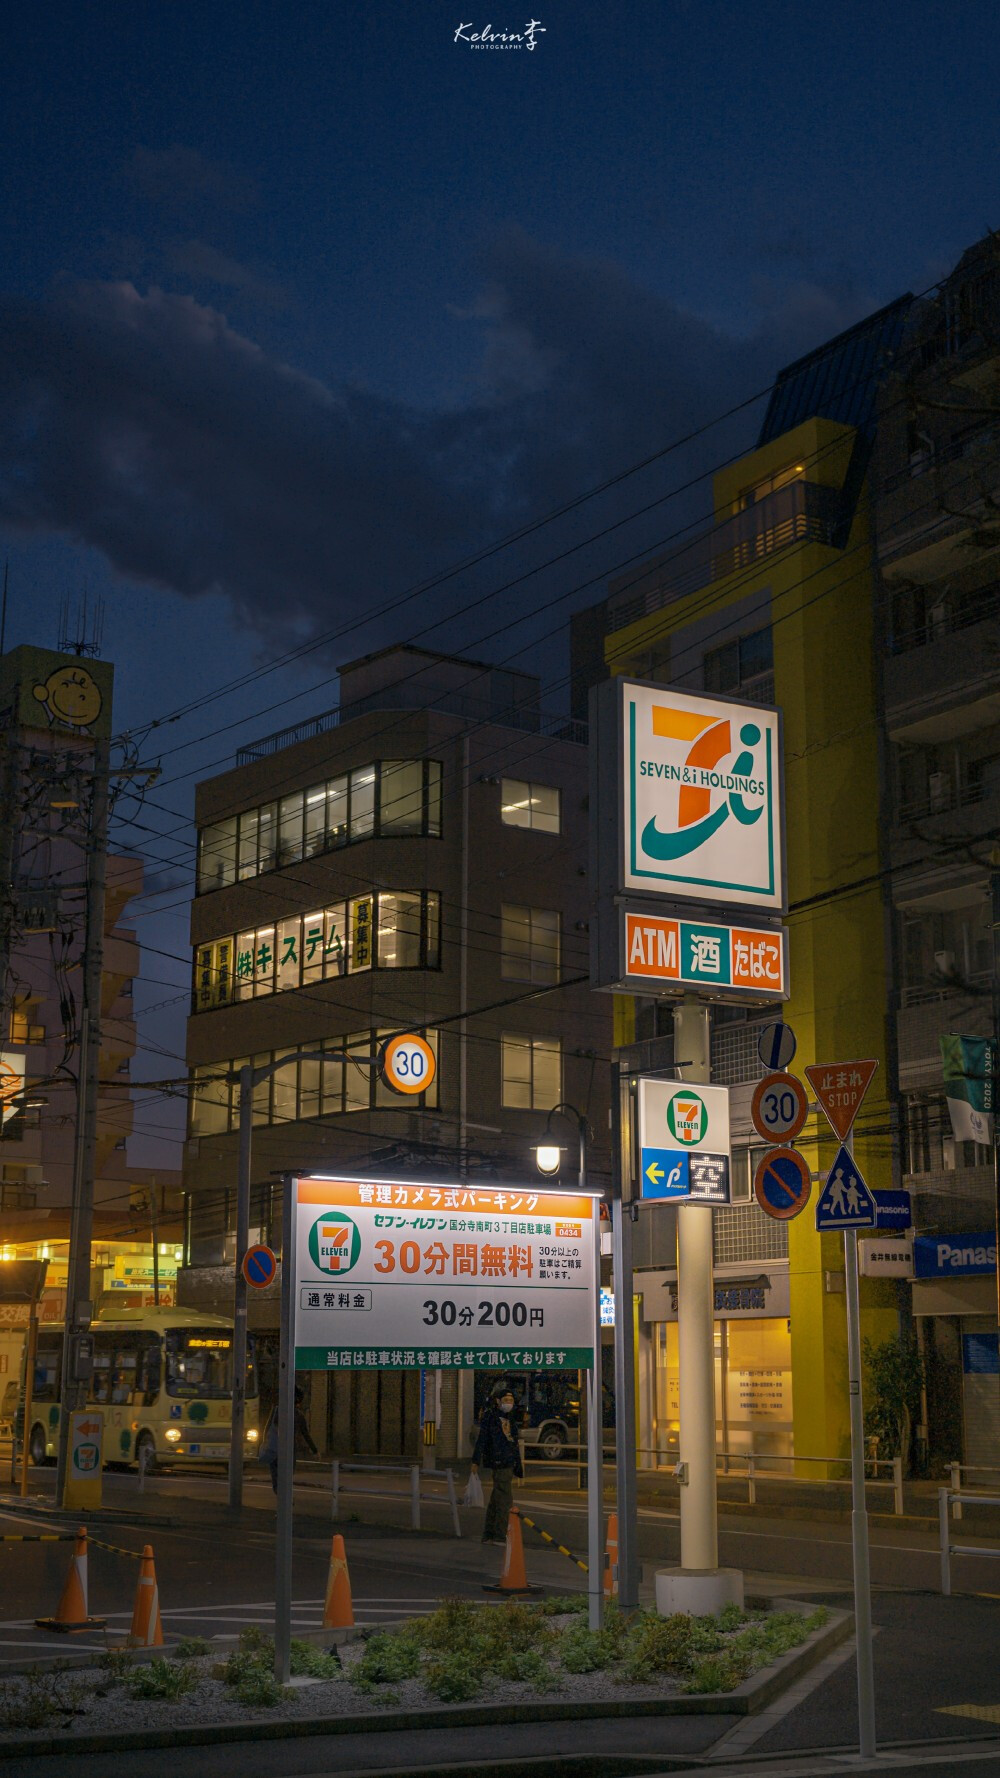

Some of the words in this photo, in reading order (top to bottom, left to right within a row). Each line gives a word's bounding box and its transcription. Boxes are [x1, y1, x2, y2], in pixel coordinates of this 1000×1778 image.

[701, 772, 765, 796] HOLDINGS
[357, 903, 370, 966] 募集中
[630, 926, 677, 969] ATM
[690, 933, 722, 974] 酒
[734, 939, 780, 980] たばこ
[397, 1051, 424, 1077] 30
[821, 1070, 863, 1090] 止まれ
[765, 1092, 795, 1123] 30
[828, 1092, 857, 1108] STOP
[984, 1082, 992, 1109] 2020
[690, 1156, 725, 1199] 空
[358, 1184, 539, 1211] 管理カメラ式パーキング
[559, 1229, 578, 1237] 0434
[374, 1240, 534, 1278] 30分間無料
[539, 1246, 579, 1257] 30分以上の
[539, 1258, 582, 1269] 駐車はご精算
[308, 1293, 365, 1308] 通常料金
[327, 1350, 567, 1366] 当店は駐車状況を確認させて頂いております
